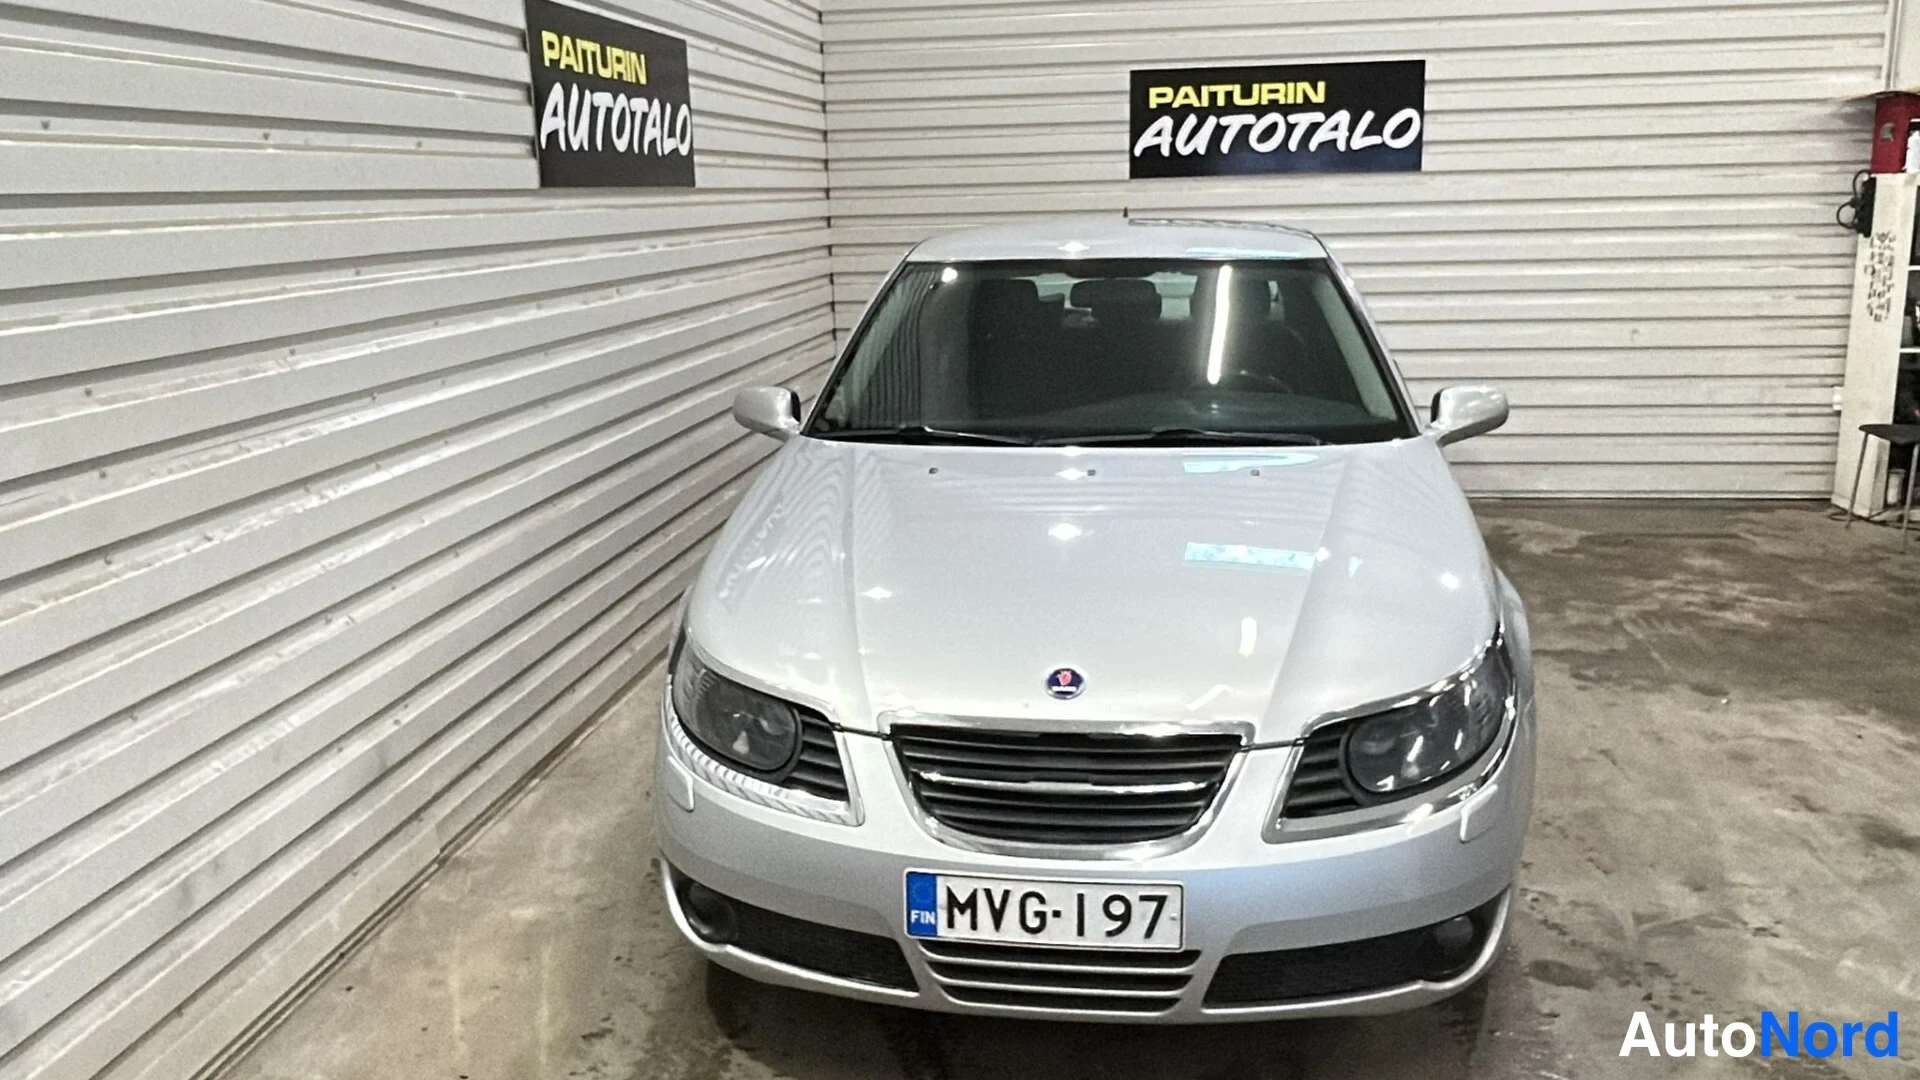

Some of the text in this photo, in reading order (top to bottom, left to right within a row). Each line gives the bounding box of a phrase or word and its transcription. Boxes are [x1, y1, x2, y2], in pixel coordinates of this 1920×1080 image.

[541, 30, 647, 85] PAITURIN
[540, 81, 692, 156] AUTOTALO
[1149, 81, 1326, 108] PAITURIN
[1133, 108, 1421, 157] AUTOTALO
[910, 909, 936, 925] FIN
[946, 885, 1169, 940] MVG-197
